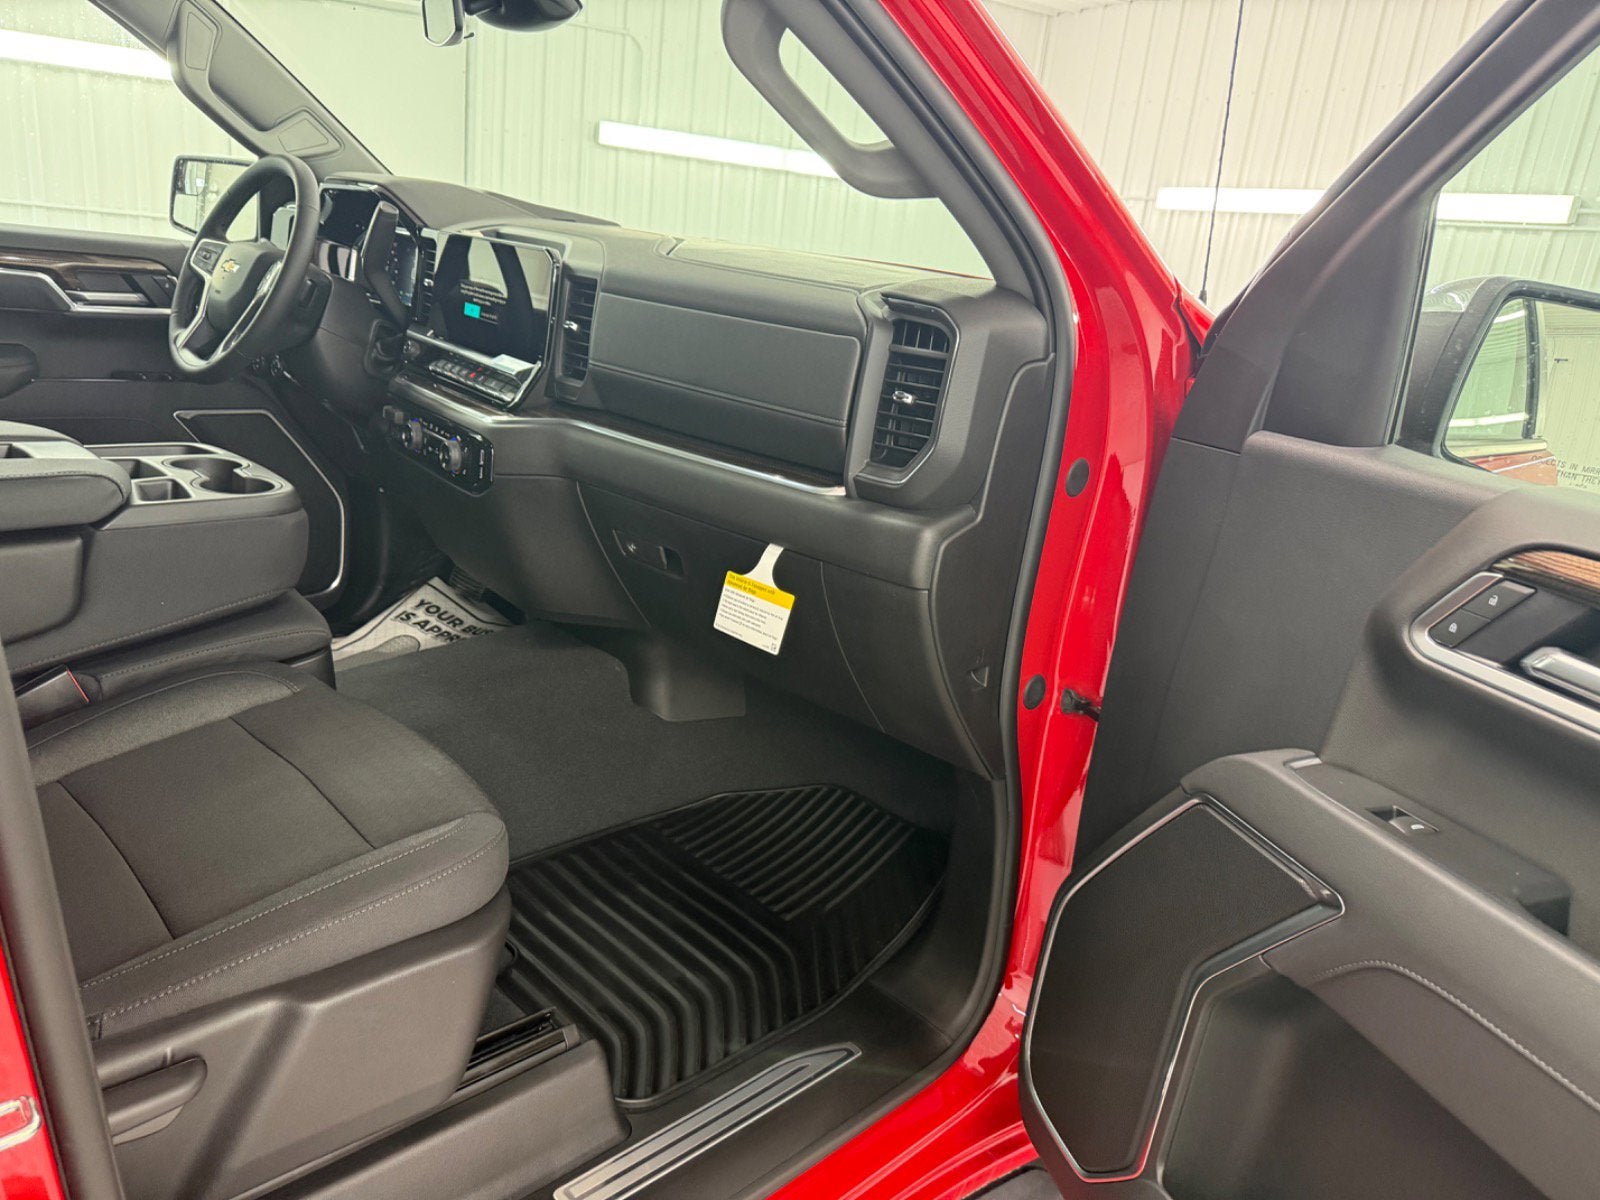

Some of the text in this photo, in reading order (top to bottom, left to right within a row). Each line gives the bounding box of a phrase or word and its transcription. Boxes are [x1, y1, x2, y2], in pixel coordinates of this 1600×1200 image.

[1569, 463, 1579, 471] IN
[395, 611, 466, 642] IS APPR
[415, 599, 464, 628] YOUR
